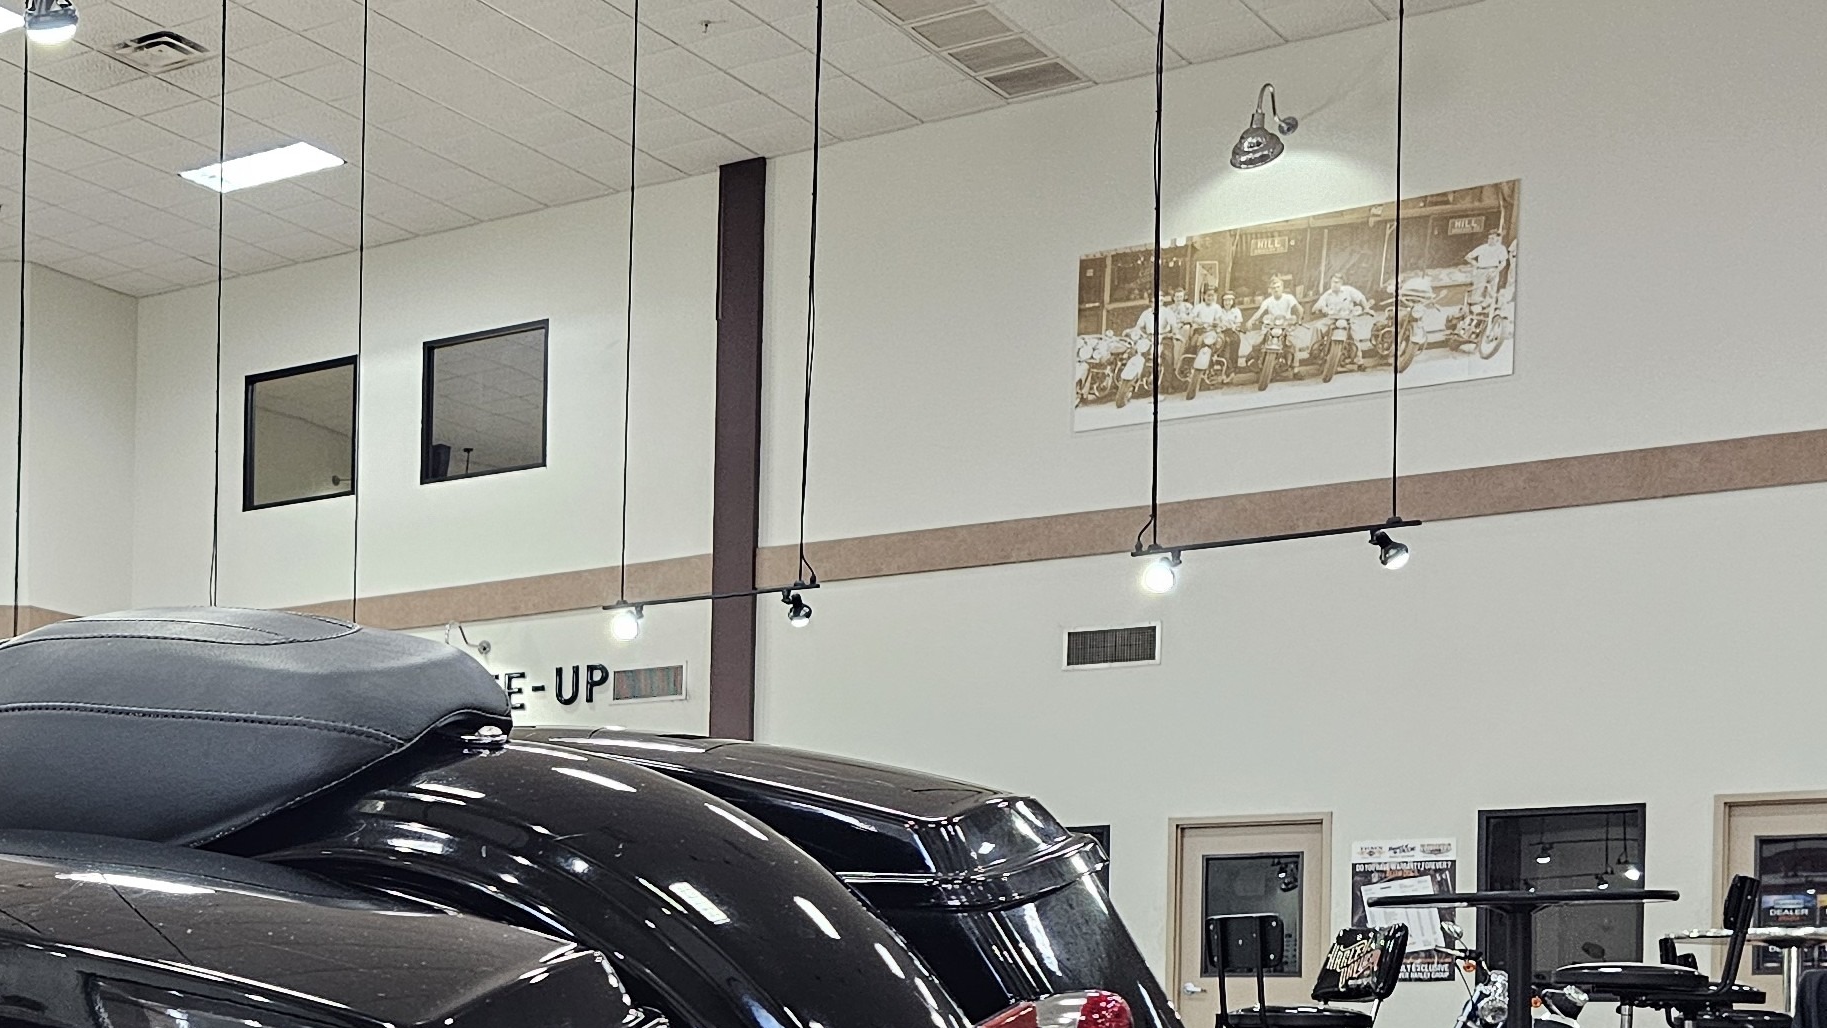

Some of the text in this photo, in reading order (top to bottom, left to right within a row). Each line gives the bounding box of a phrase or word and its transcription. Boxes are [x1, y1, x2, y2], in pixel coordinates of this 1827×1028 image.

[1454, 219, 1478, 228] HILL
[1257, 238, 1281, 249] HILL
[494, 663, 610, 711] E-UP
[1769, 908, 1809, 917] DEALER
